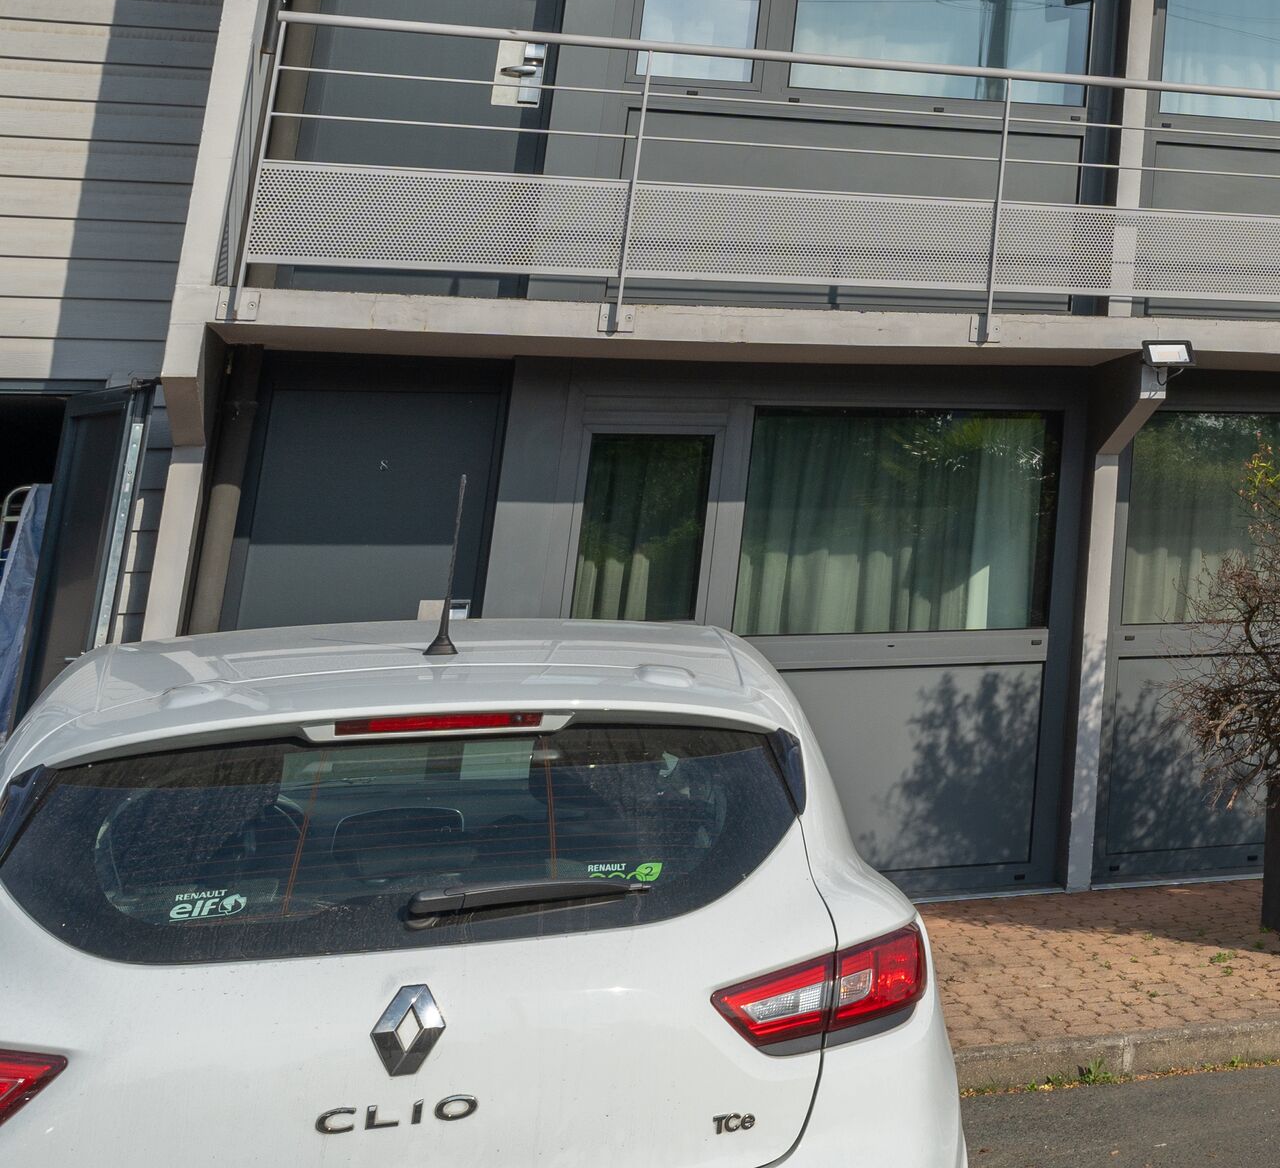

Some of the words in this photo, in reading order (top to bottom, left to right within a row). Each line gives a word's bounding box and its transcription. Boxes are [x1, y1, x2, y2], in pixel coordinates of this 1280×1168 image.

[587, 863, 627, 872] RENAULT
[175, 889, 228, 902] RENAULT
[169, 897, 220, 919] elf
[315, 1094, 479, 1134] CLIO
[712, 1112, 756, 1135] TCe
